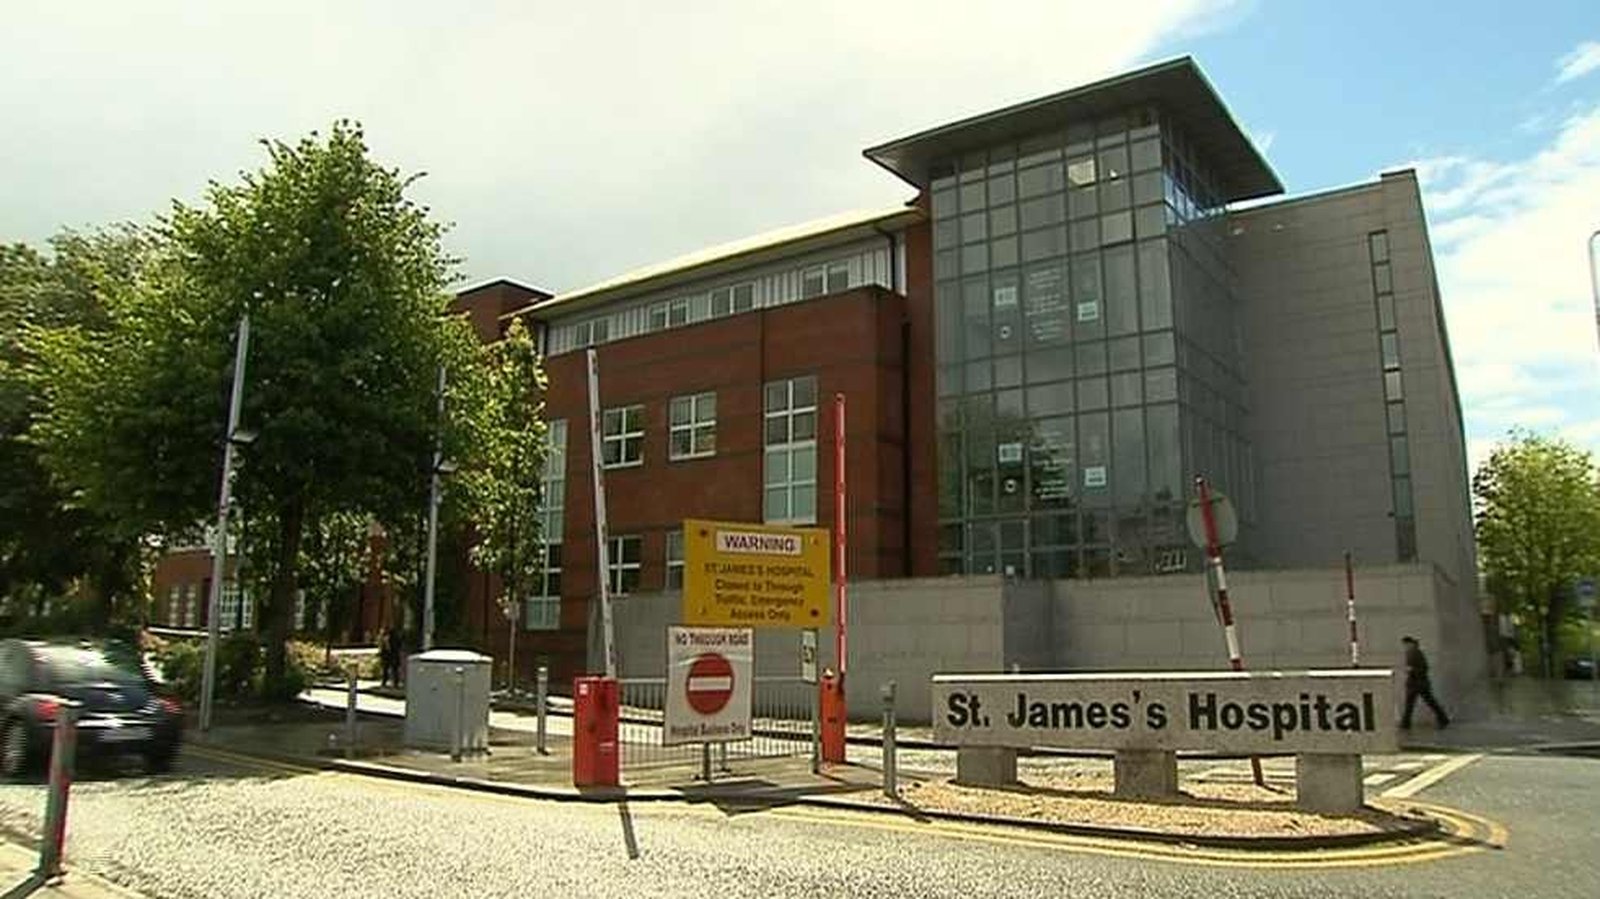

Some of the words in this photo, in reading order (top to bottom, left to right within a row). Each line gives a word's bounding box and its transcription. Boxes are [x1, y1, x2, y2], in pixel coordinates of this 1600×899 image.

[725, 534, 796, 553] WARNING
[766, 565, 814, 579] HOSPITAL
[753, 580, 762, 591] to
[765, 580, 804, 595] Through
[751, 595, 805, 608] Emergency
[730, 609, 765, 620] Access
[767, 609, 791, 621] Only
[675, 633, 687, 645] NO
[689, 633, 726, 645] THROUGH
[728, 633, 749, 645] ROAD
[946, 691, 990, 728] St.
[1007, 690, 1168, 729] James's
[1188, 692, 1376, 740] Hospital
